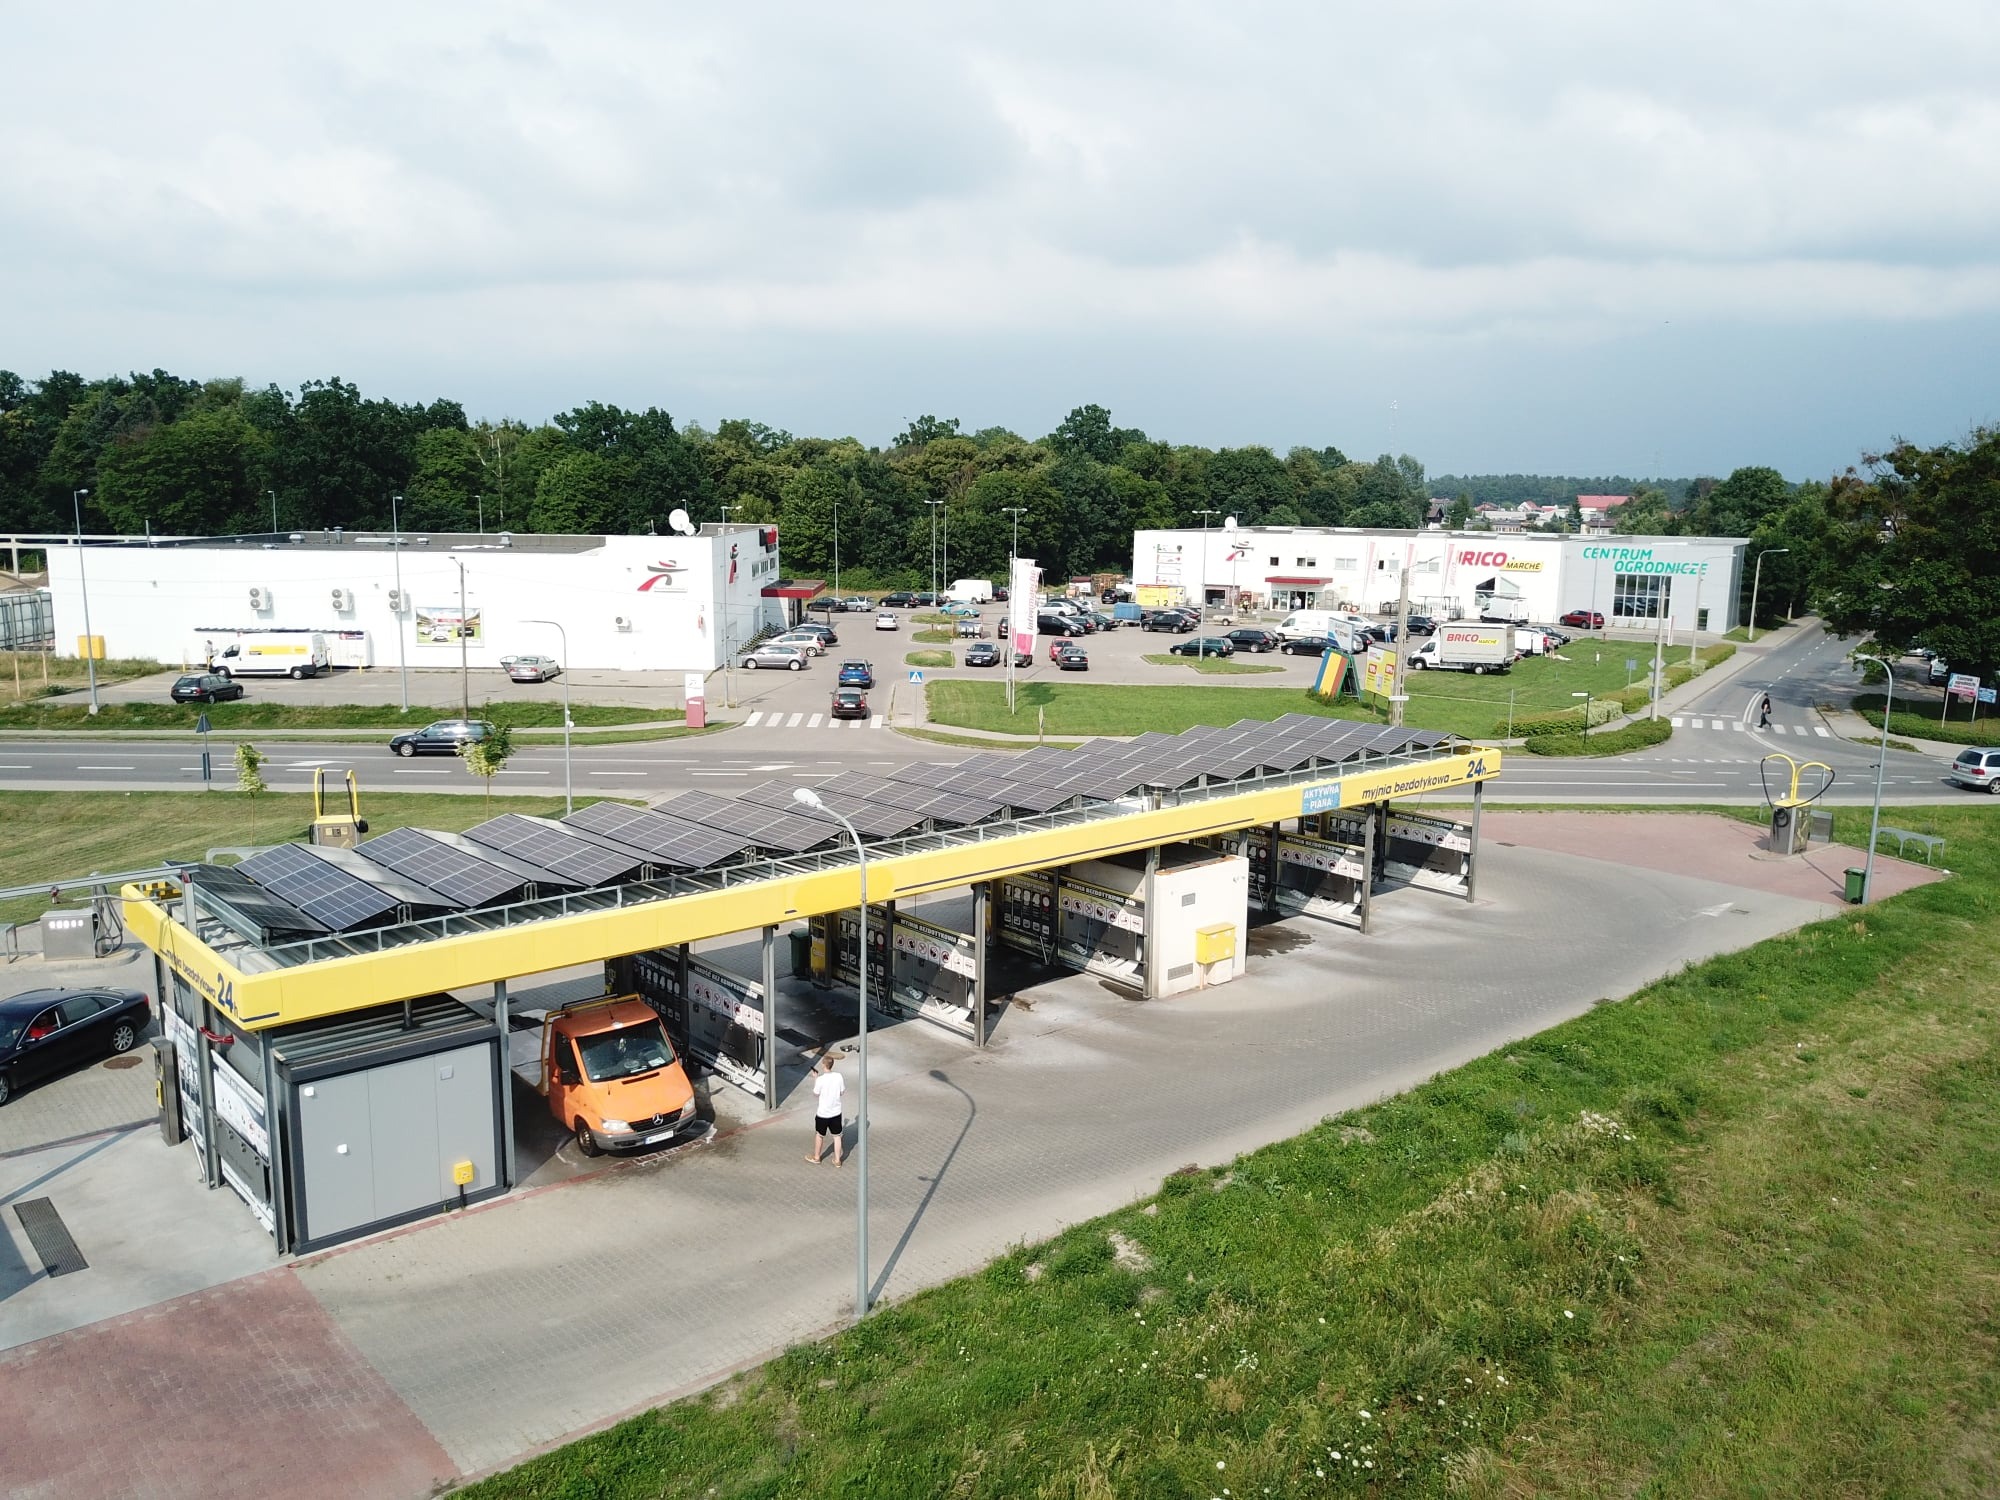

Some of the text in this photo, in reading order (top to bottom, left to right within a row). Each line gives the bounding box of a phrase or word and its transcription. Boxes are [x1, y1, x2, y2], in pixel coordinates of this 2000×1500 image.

[1583, 547, 1653, 560] CENTRUM
[1613, 561, 1708, 576] OGRODNICZE
[1446, 633, 1479, 643] BRICO
[1466, 758, 1487, 778] 24h
[1303, 784, 1340, 799] AKTYWNA
[1361, 774, 1450, 801] myjnia bezdotykowa
[1309, 797, 1333, 809] PIANA
